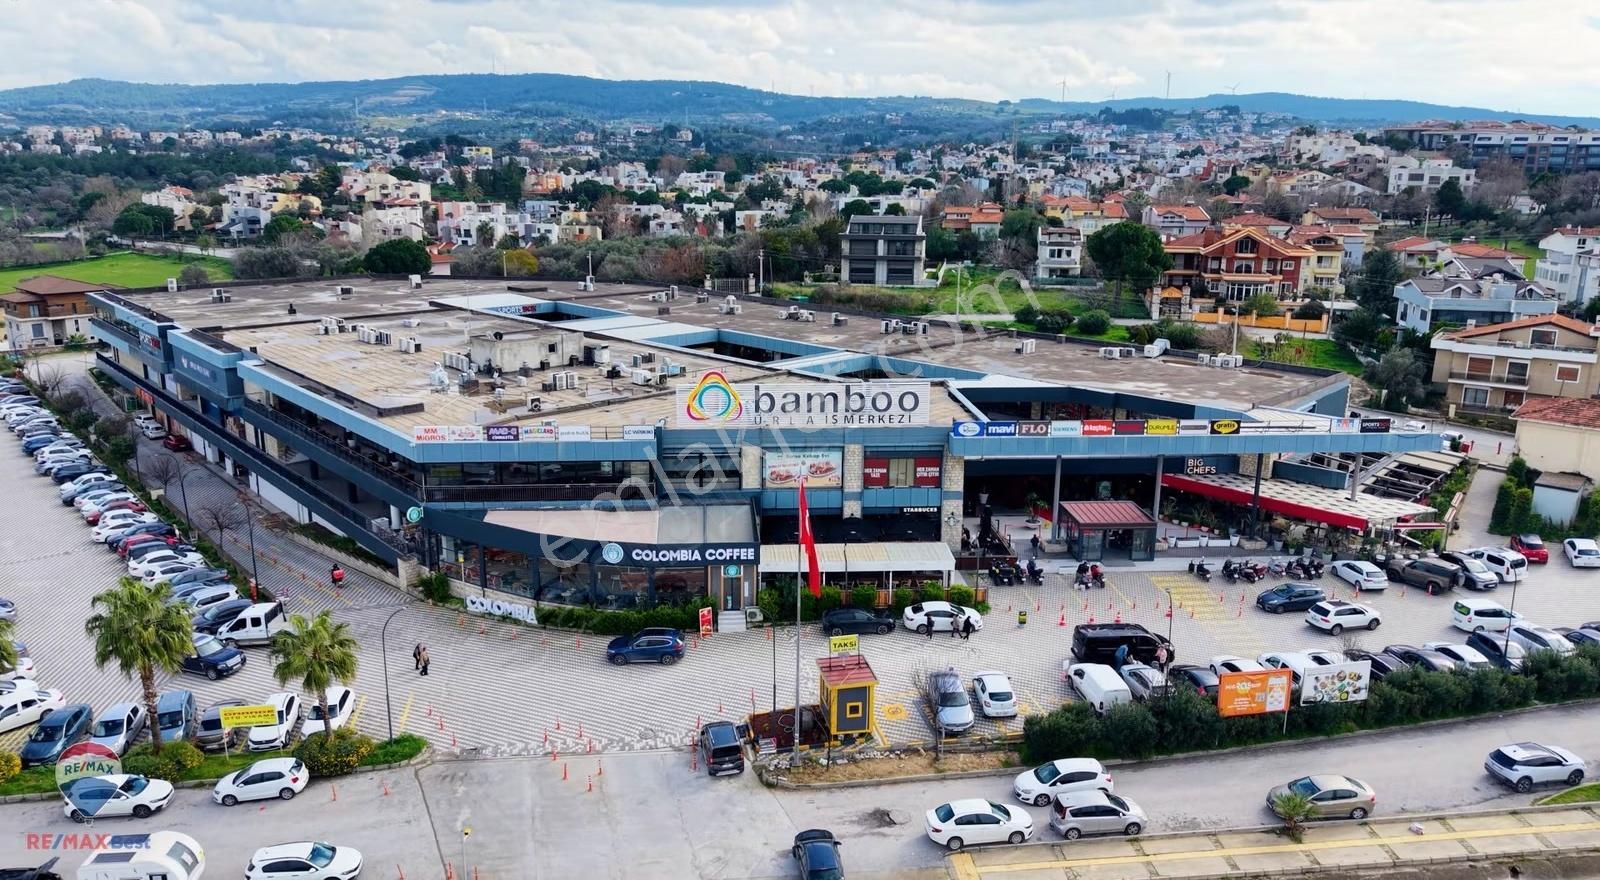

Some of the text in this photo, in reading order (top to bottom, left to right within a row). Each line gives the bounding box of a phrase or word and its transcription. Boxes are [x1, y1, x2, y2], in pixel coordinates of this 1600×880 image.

[754, 384, 919, 413] bamboo
[754, 415, 814, 425] URLA
[988, 424, 1014, 433] mavi
[1021, 424, 1047, 434] FLO
[1188, 459, 1204, 467] BIG
[1187, 466, 1216, 474] CHEFS
[632, 548, 754, 562] COLOMBIA COFFEE
[466, 595, 537, 624] COLOMBIA
